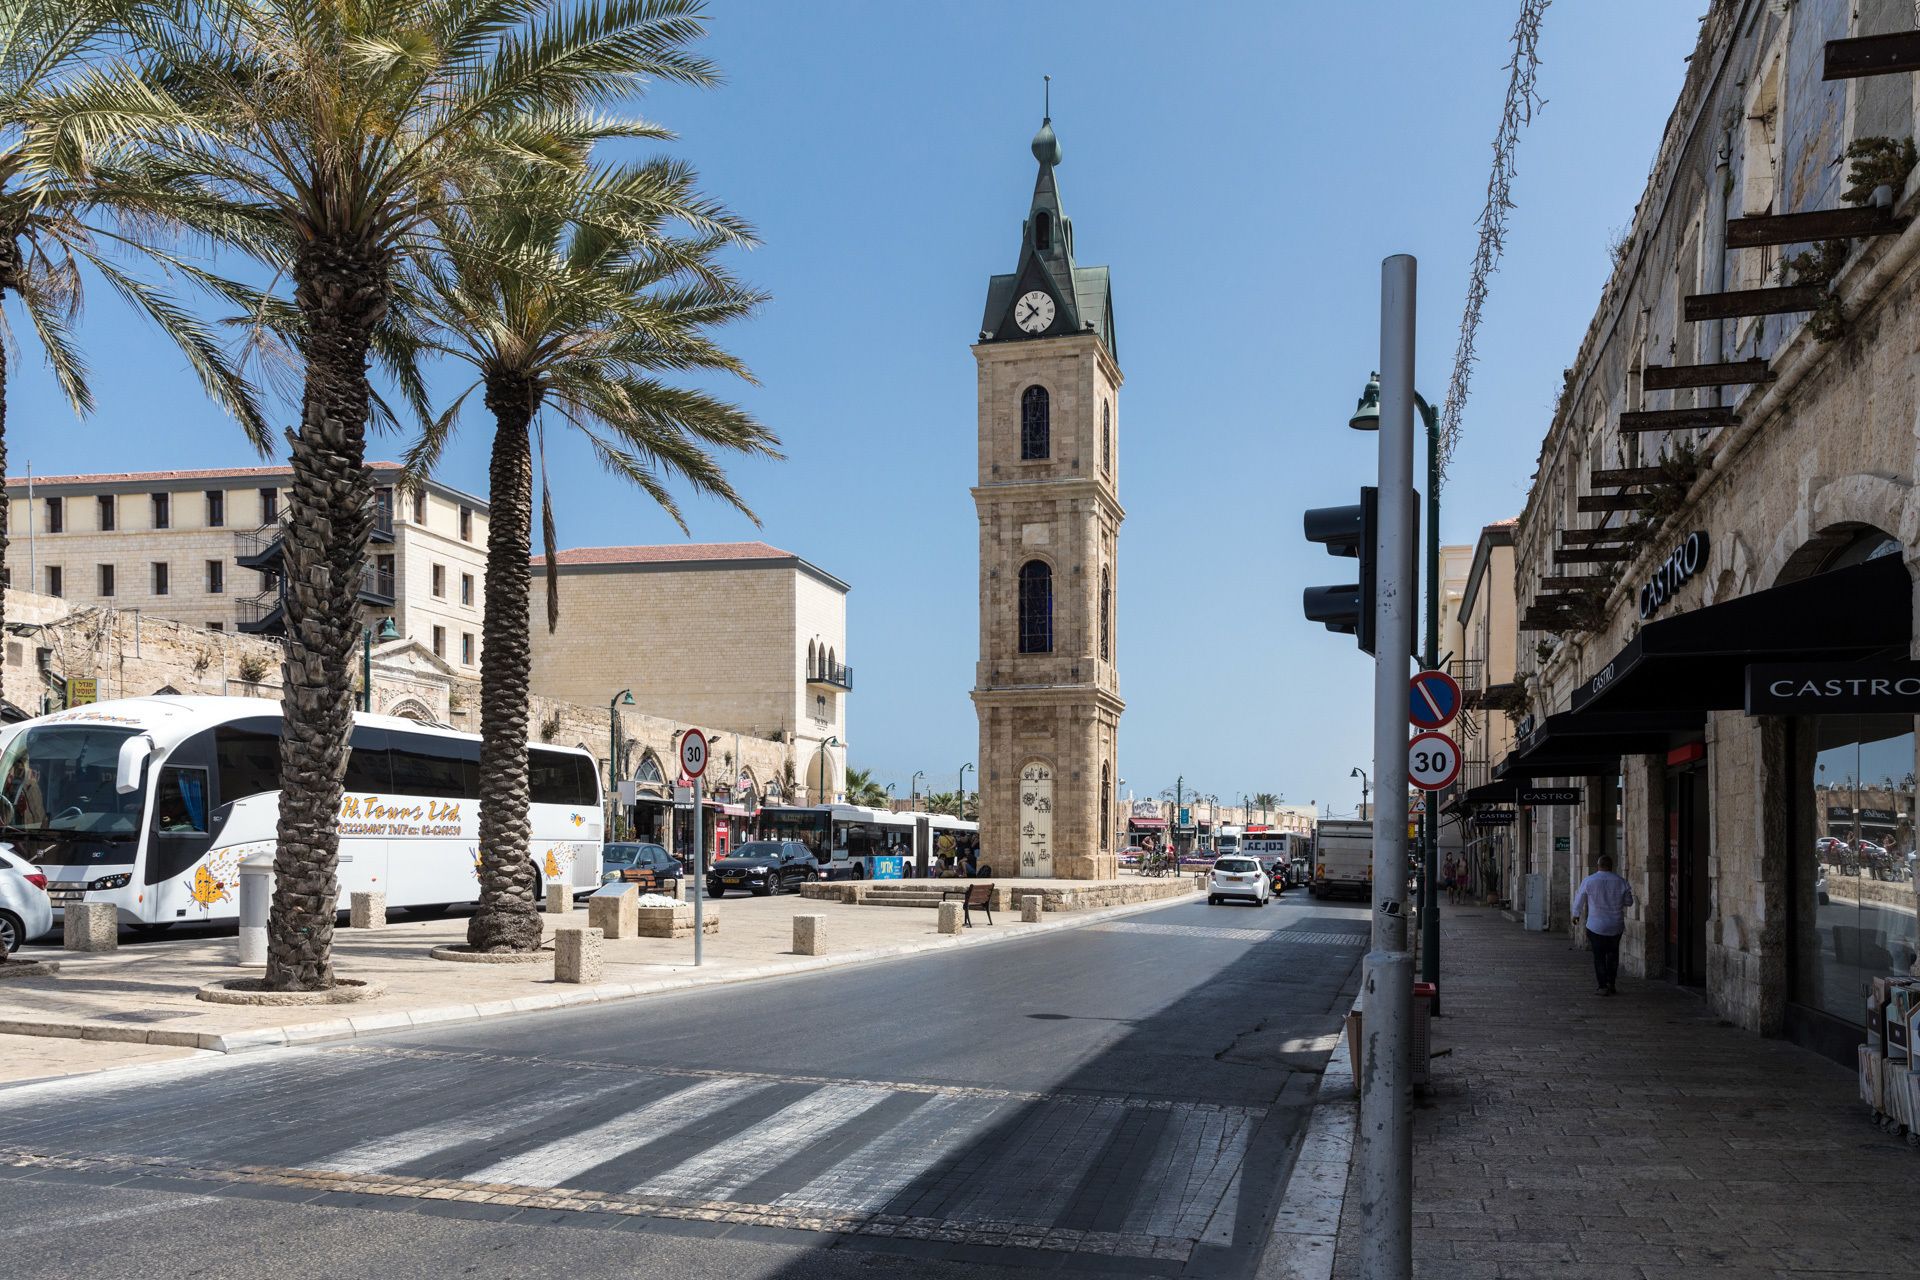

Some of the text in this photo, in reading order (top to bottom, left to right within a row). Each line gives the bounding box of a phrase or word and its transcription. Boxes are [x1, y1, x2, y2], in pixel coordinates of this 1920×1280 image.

[1640, 531, 1702, 619] CASTRO
[1592, 662, 1614, 693] CASTRO
[1769, 677, 1920, 697] CASTRO
[687, 746, 701, 763] 30
[1414, 752, 1447, 773] 30
[1523, 792, 1574, 800] CASTRO
